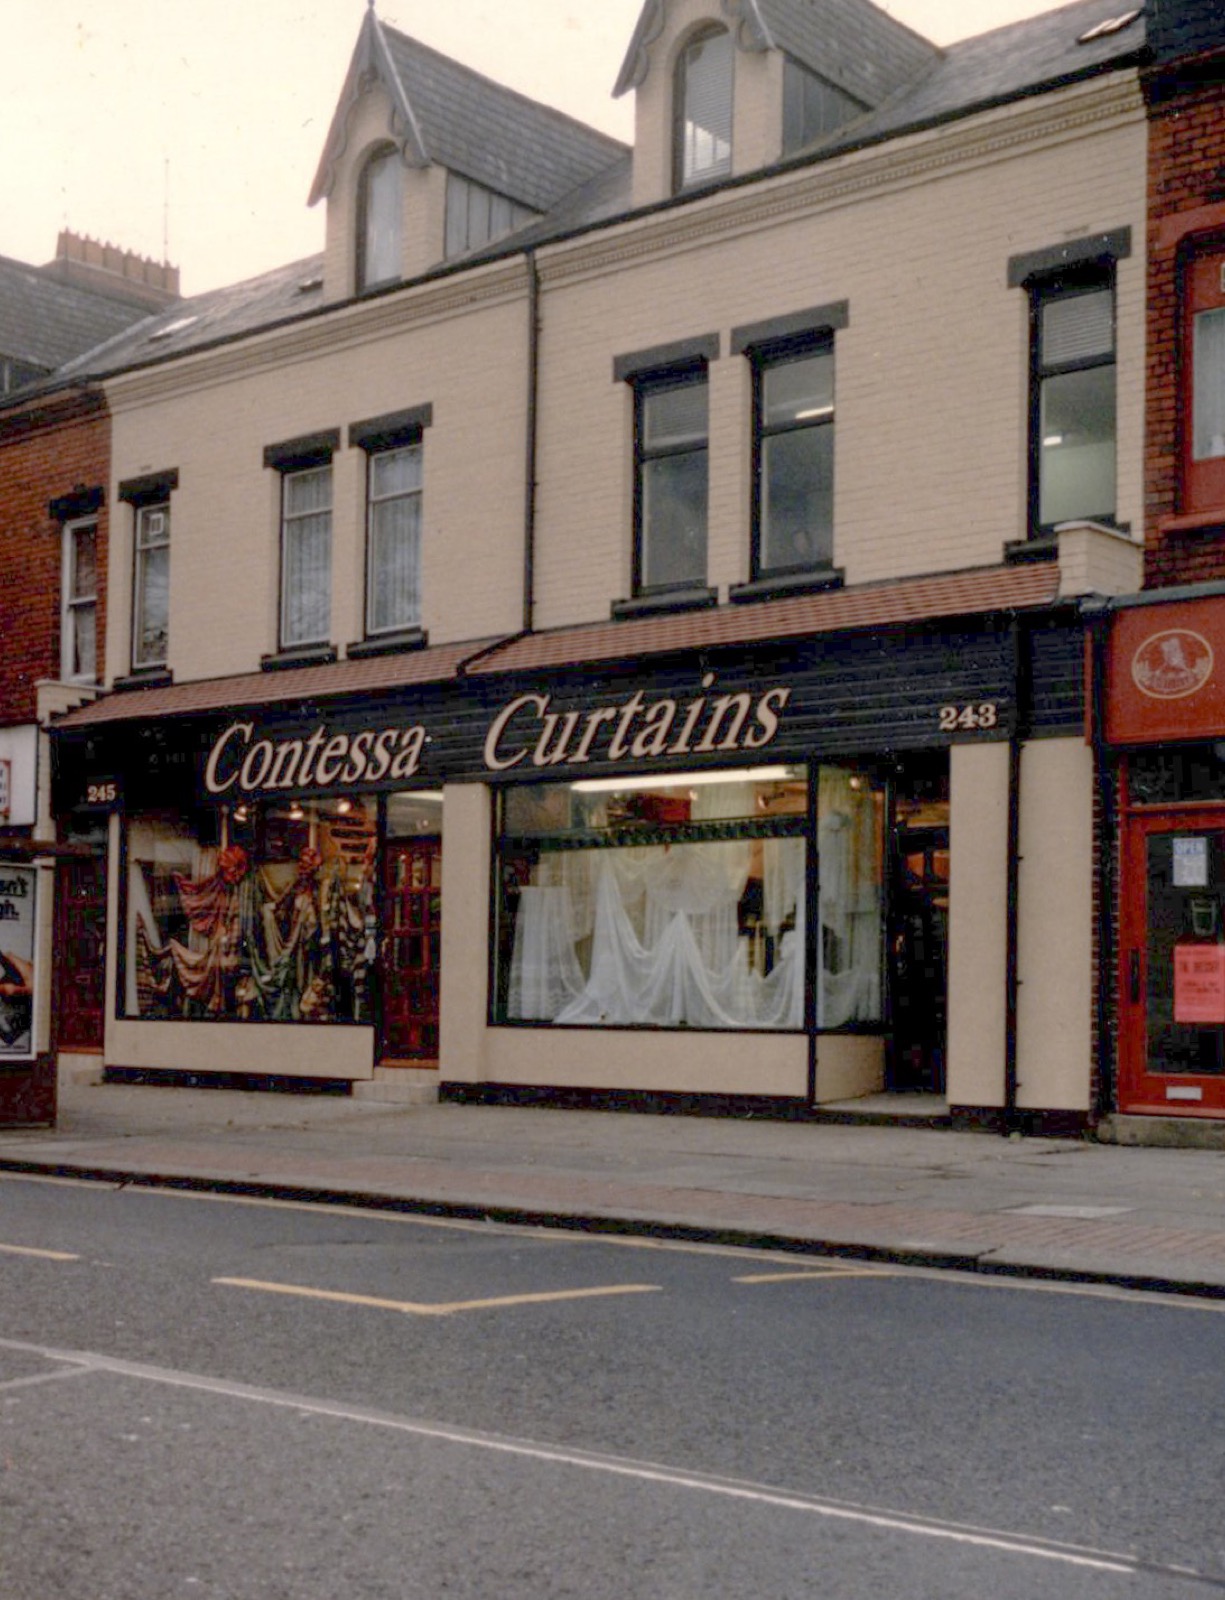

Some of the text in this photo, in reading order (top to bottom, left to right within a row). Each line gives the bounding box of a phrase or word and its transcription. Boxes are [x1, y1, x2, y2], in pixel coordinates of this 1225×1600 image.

[939, 703, 997, 730] 243
[206, 673, 790, 793] Contessa Curtains
[87, 783, 116, 802] 245
